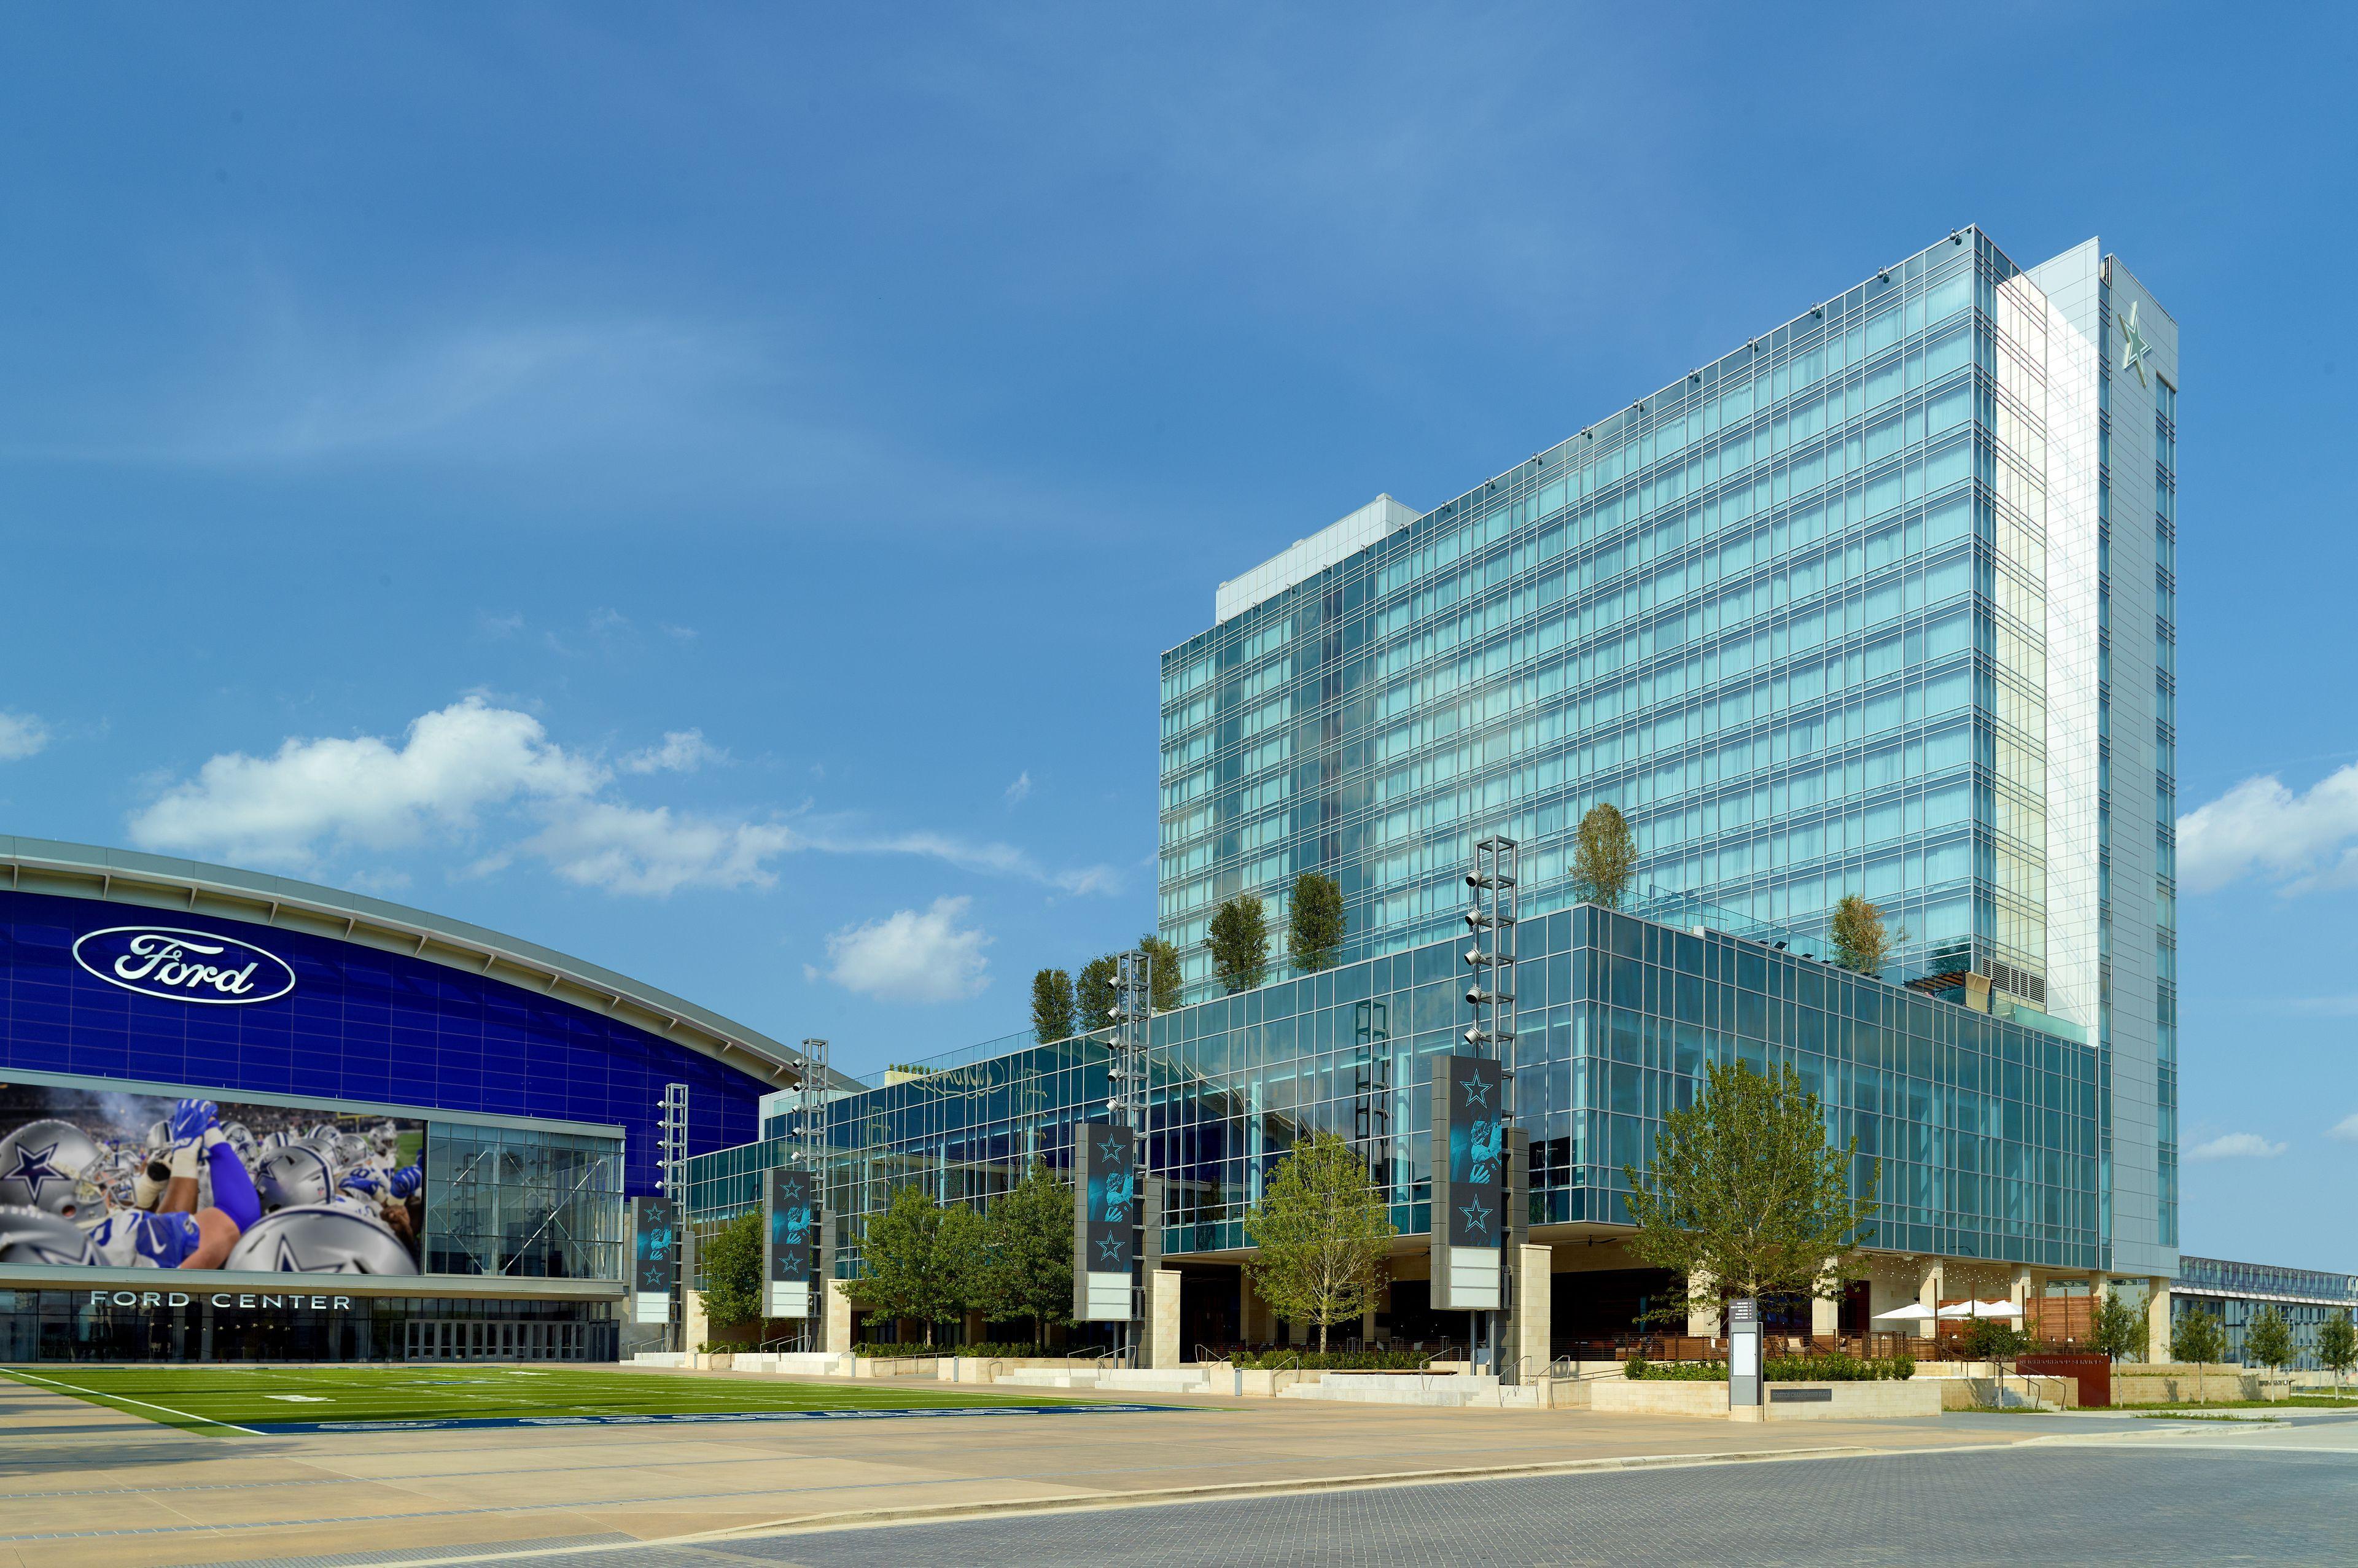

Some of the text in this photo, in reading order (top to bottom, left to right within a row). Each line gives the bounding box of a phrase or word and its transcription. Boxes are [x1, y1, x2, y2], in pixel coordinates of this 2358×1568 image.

[114, 934, 259, 994] Ford
[90, 1290, 351, 1310] FORD CENTER
